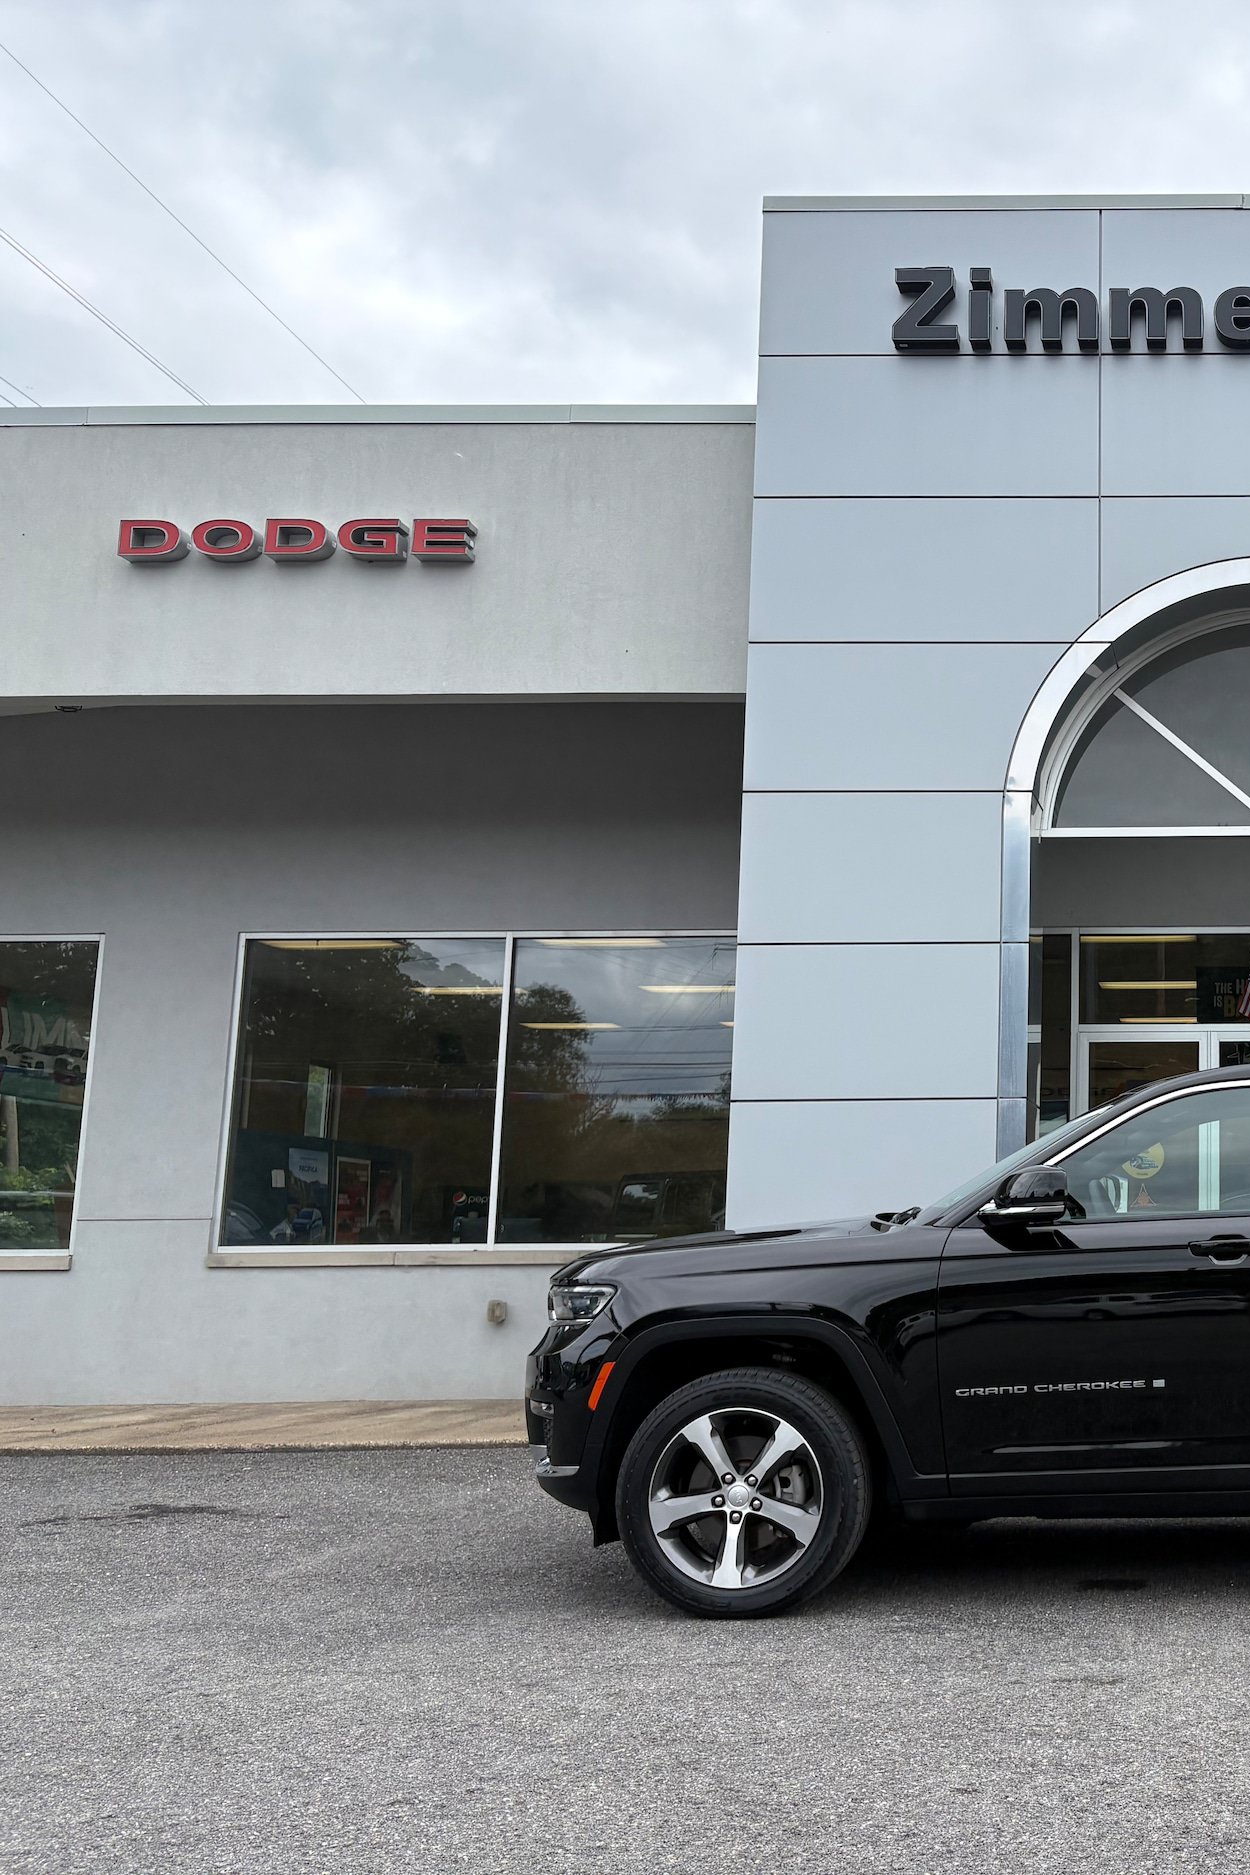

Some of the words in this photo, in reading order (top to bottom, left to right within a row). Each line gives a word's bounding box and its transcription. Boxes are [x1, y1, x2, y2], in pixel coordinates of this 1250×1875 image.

[117, 518, 478, 563] DODGE
[1214, 982, 1233, 994] THE
[1213, 995, 1223, 1008] IS
[955, 1385, 1028, 1397] GRAND
[1033, 1379, 1147, 1393] CHEROKEE
